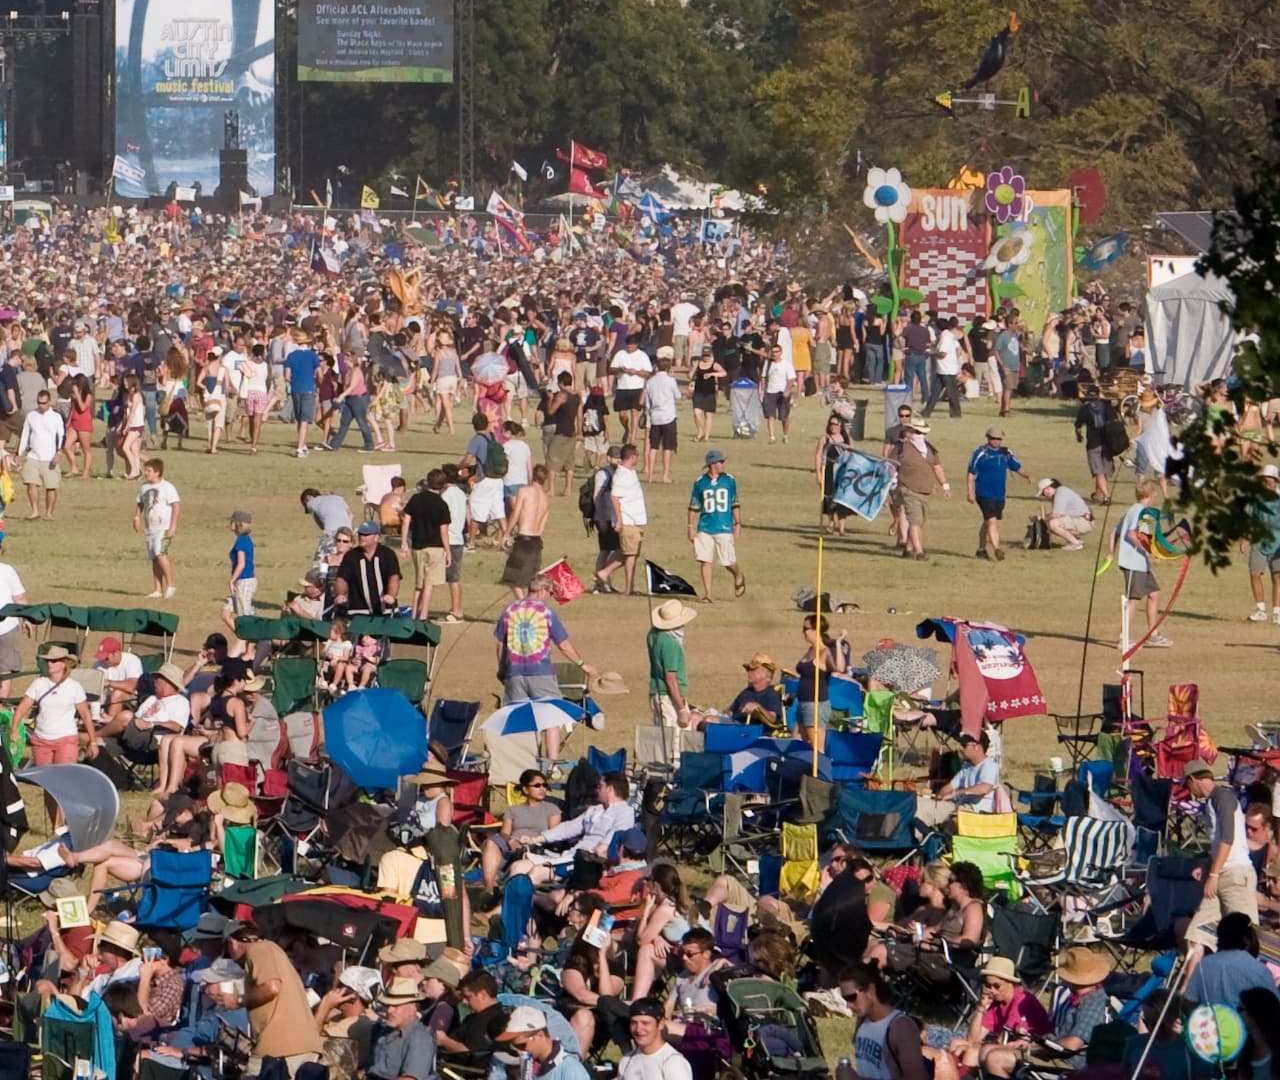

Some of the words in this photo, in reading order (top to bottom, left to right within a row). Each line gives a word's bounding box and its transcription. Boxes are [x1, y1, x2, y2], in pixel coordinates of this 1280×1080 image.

[316, 4, 349, 15] Official
[350, 4, 368, 15] ACL
[370, 4, 422, 15] Aftershows
[315, 16, 330, 25] See
[160, 22, 233, 41] AUSTIN
[171, 40, 220, 60] CITY
[164, 58, 229, 78] LIMITS
[154, 79, 188, 93] music
[191, 78, 235, 93] festival
[703, 488, 729, 513] 69
